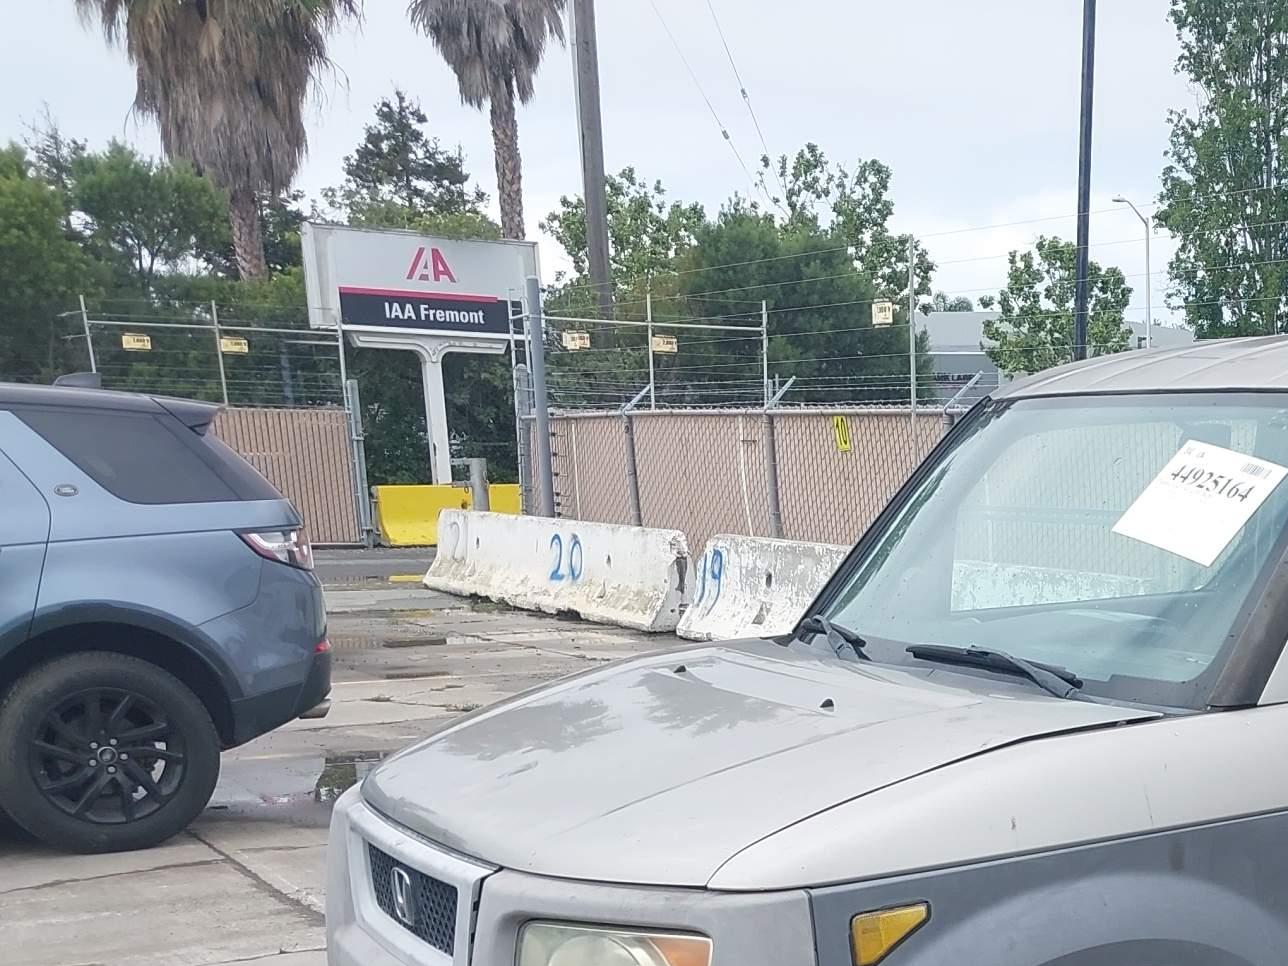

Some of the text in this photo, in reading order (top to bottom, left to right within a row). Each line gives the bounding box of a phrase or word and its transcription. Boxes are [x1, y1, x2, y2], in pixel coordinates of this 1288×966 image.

[384, 302, 485, 324] IAA Fremont
[836, 416, 848, 446] 10
[1171, 465, 1256, 502] 44925164
[550, 533, 583, 582] 20
[696, 548, 723, 617] 19
